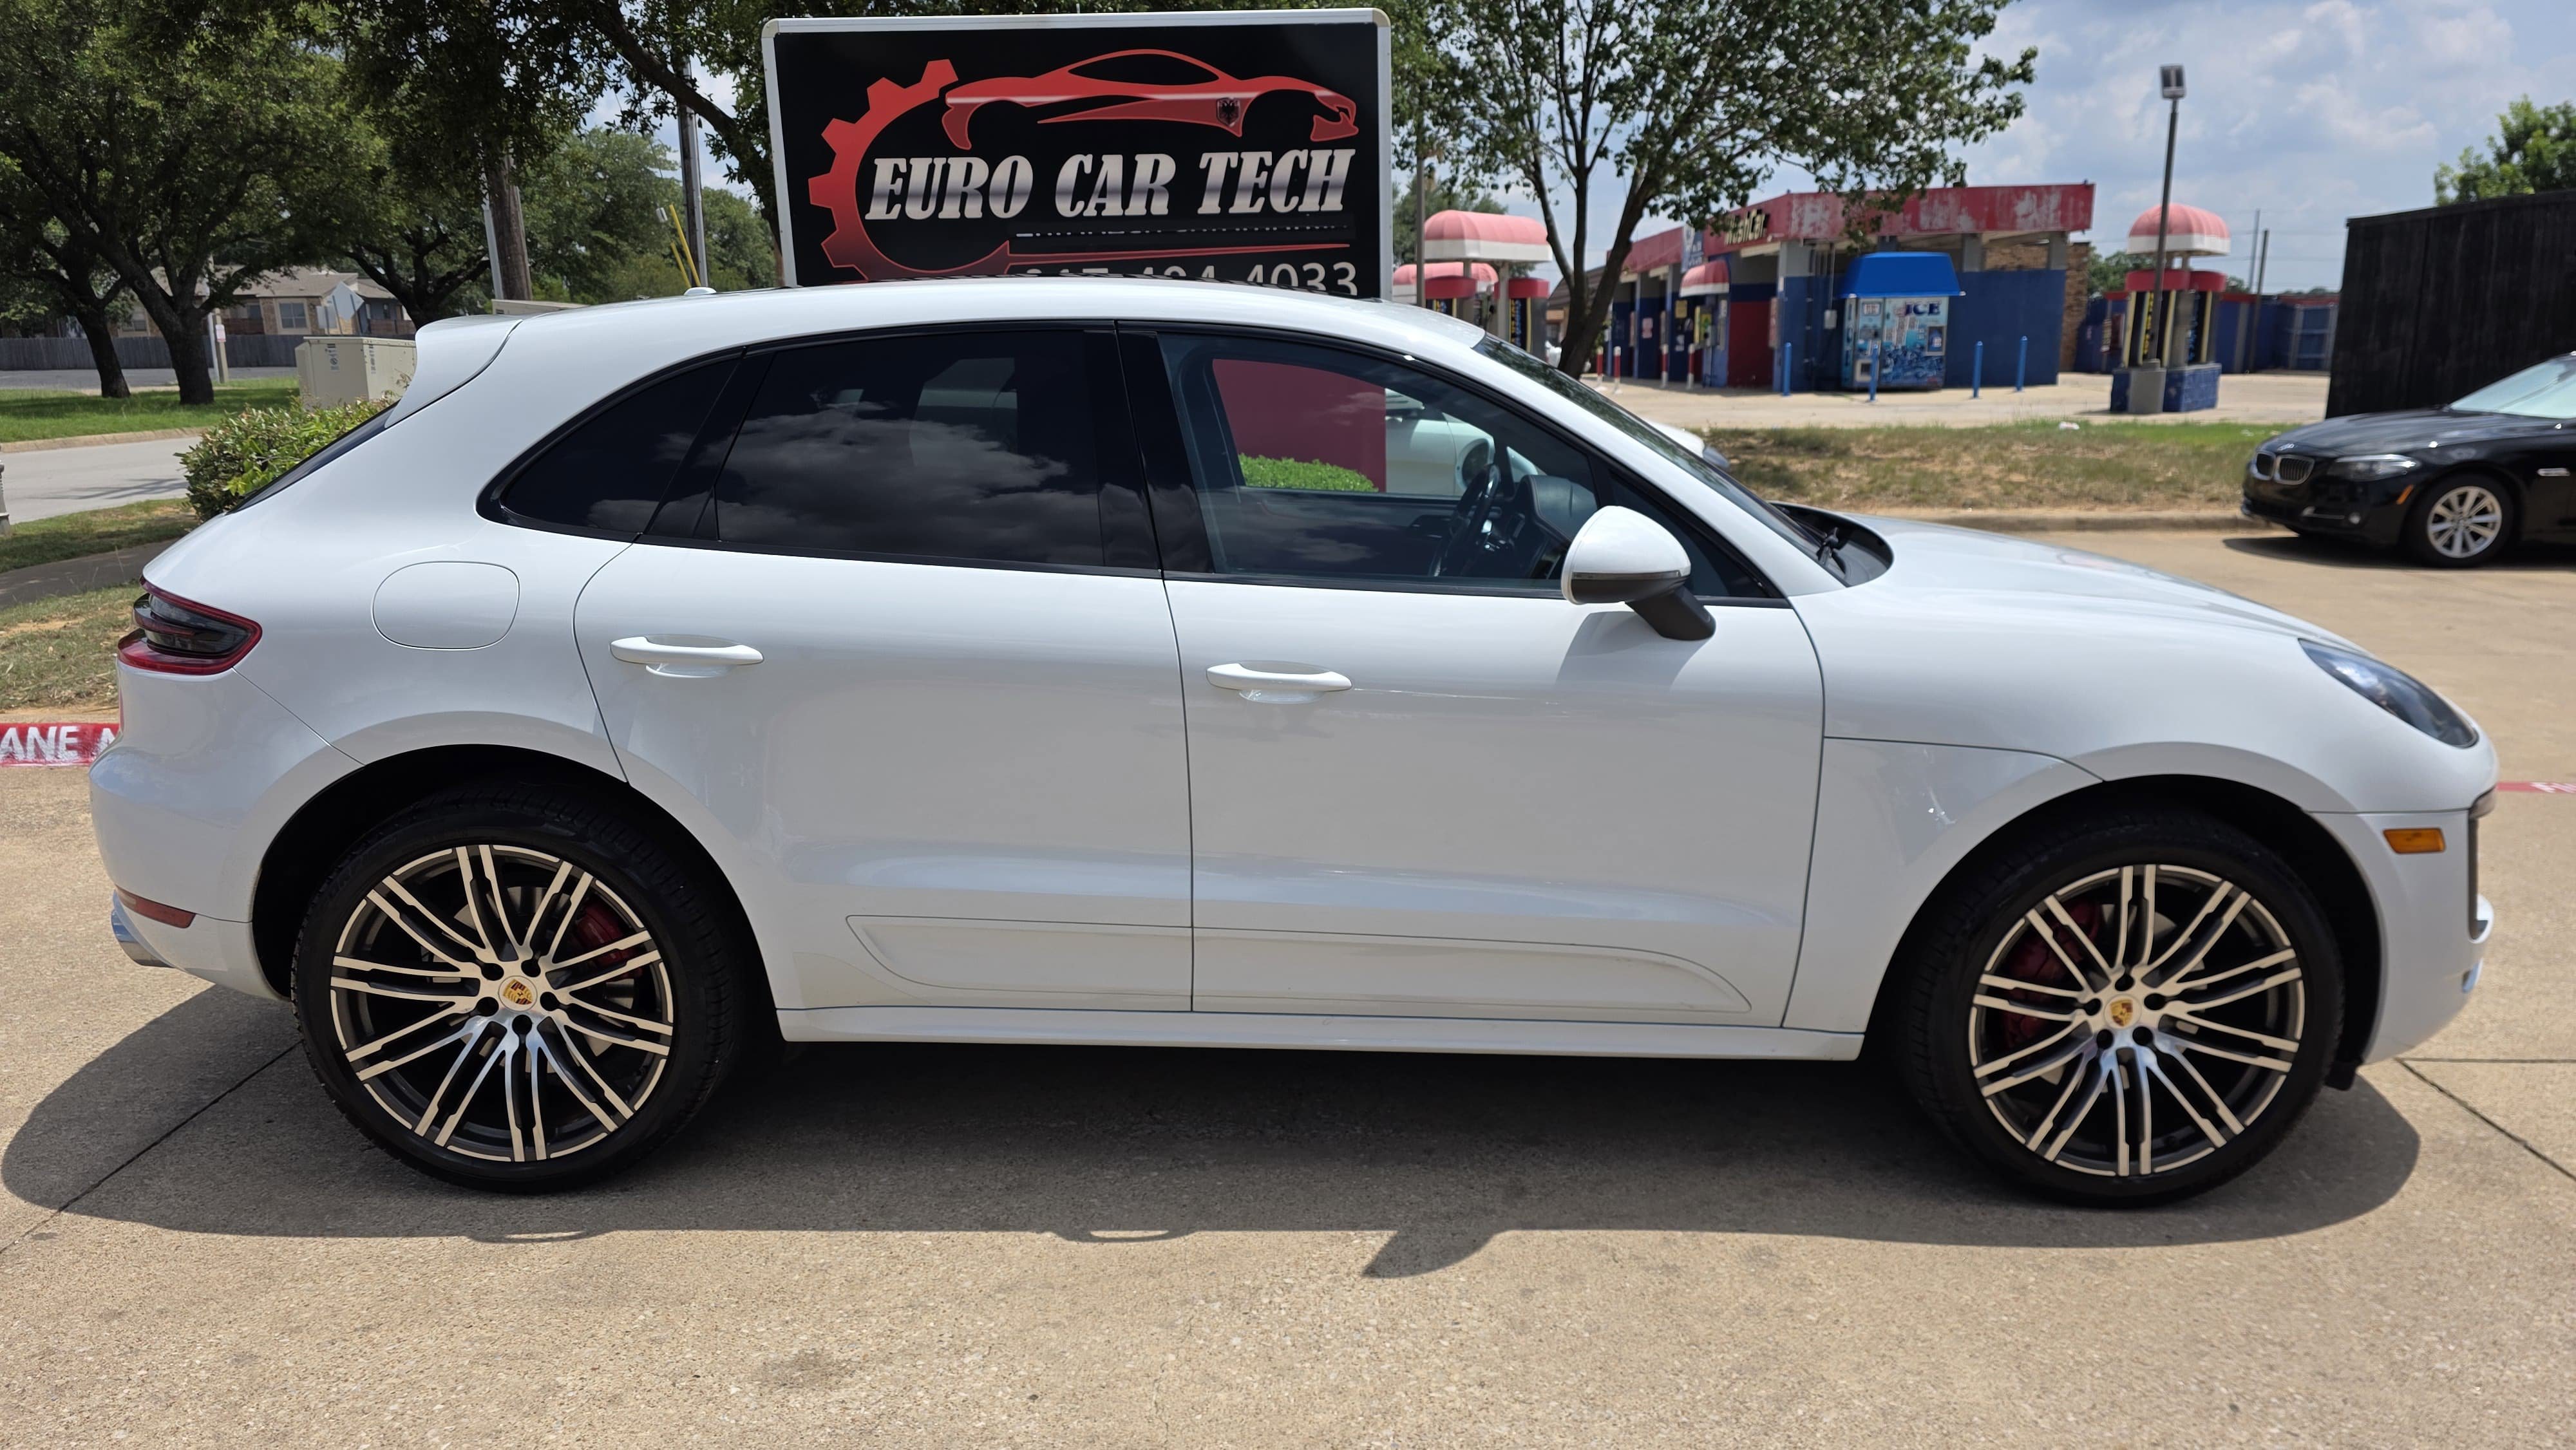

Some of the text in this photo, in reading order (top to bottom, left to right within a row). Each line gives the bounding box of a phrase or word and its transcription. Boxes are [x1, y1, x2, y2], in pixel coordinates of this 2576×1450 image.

[864, 148, 1356, 220] EURO CAR TECH
[1904, 303, 1941, 316] ICE
